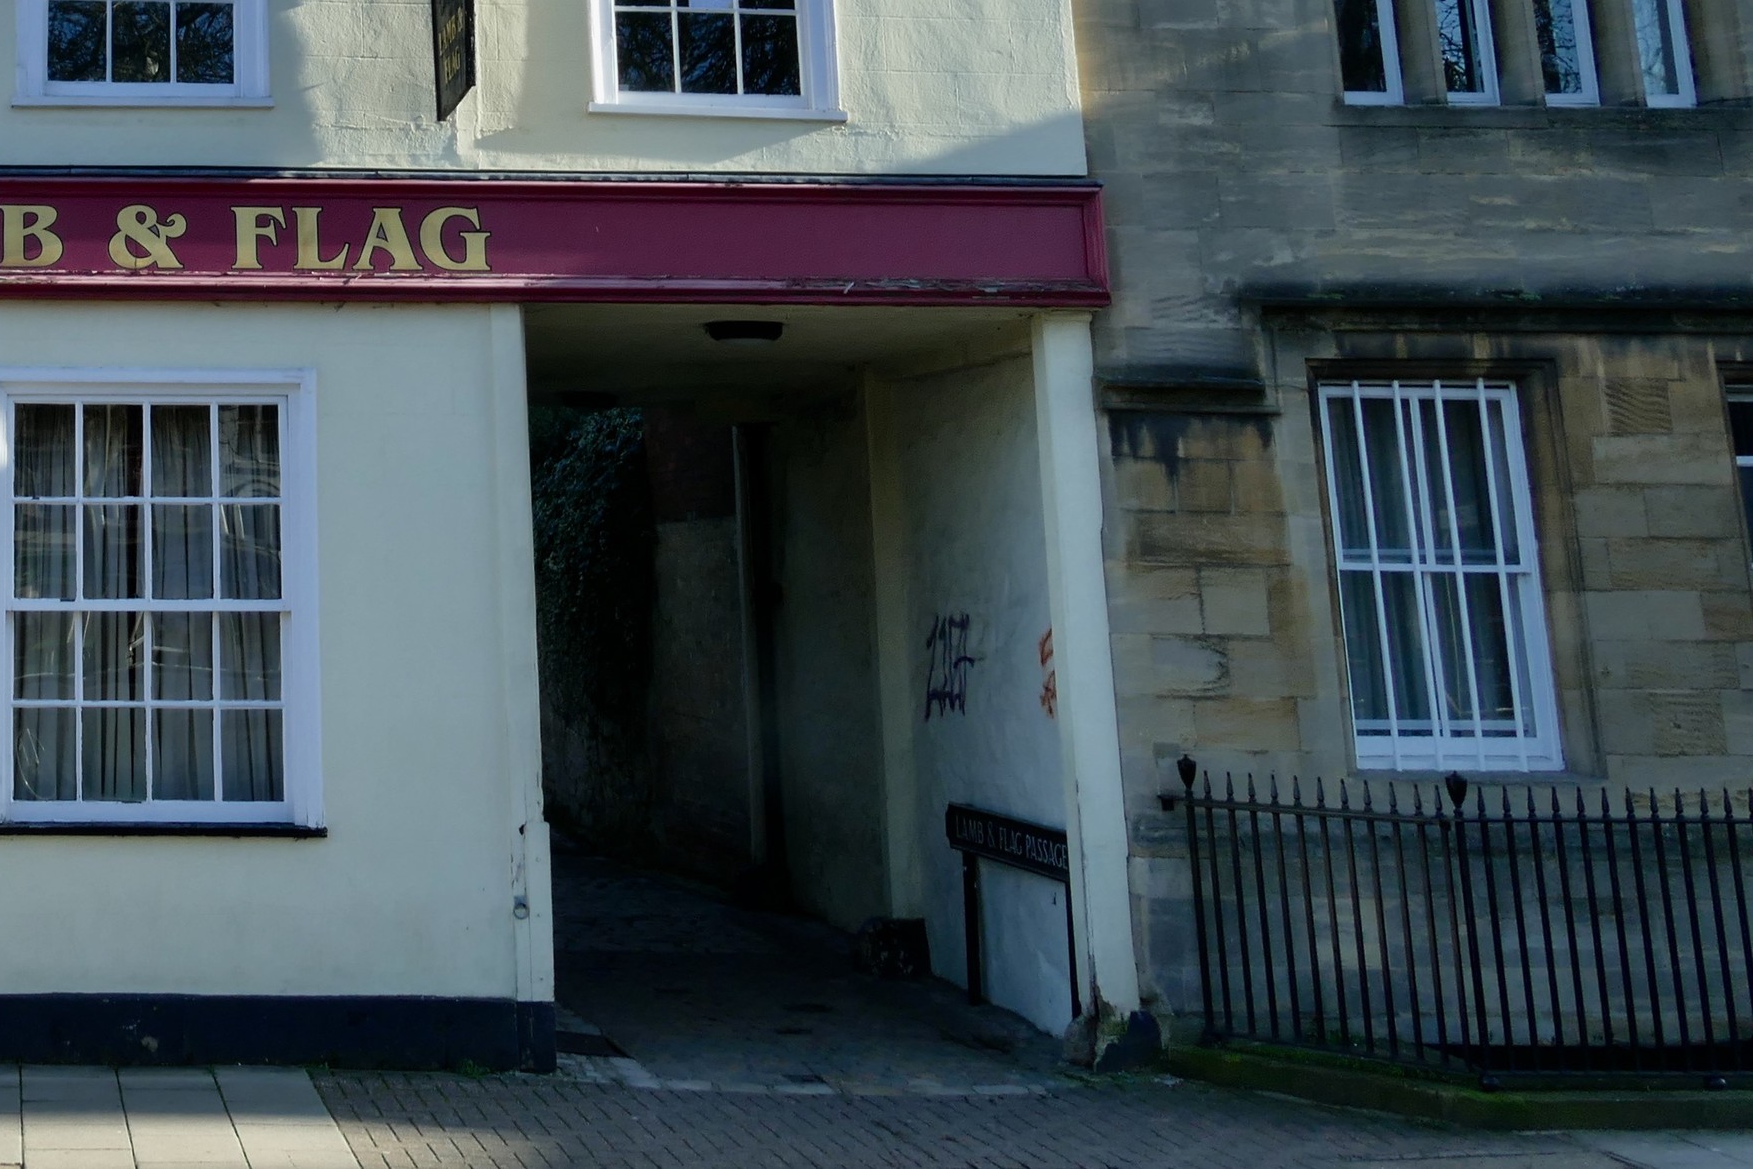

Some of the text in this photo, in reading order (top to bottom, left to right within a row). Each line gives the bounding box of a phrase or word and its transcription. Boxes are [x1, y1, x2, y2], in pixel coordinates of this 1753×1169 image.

[107, 204, 188, 270] &
[230, 206, 492, 272] FLAG
[956, 815, 1068, 870] LAMB & FLAG PASSAGE
